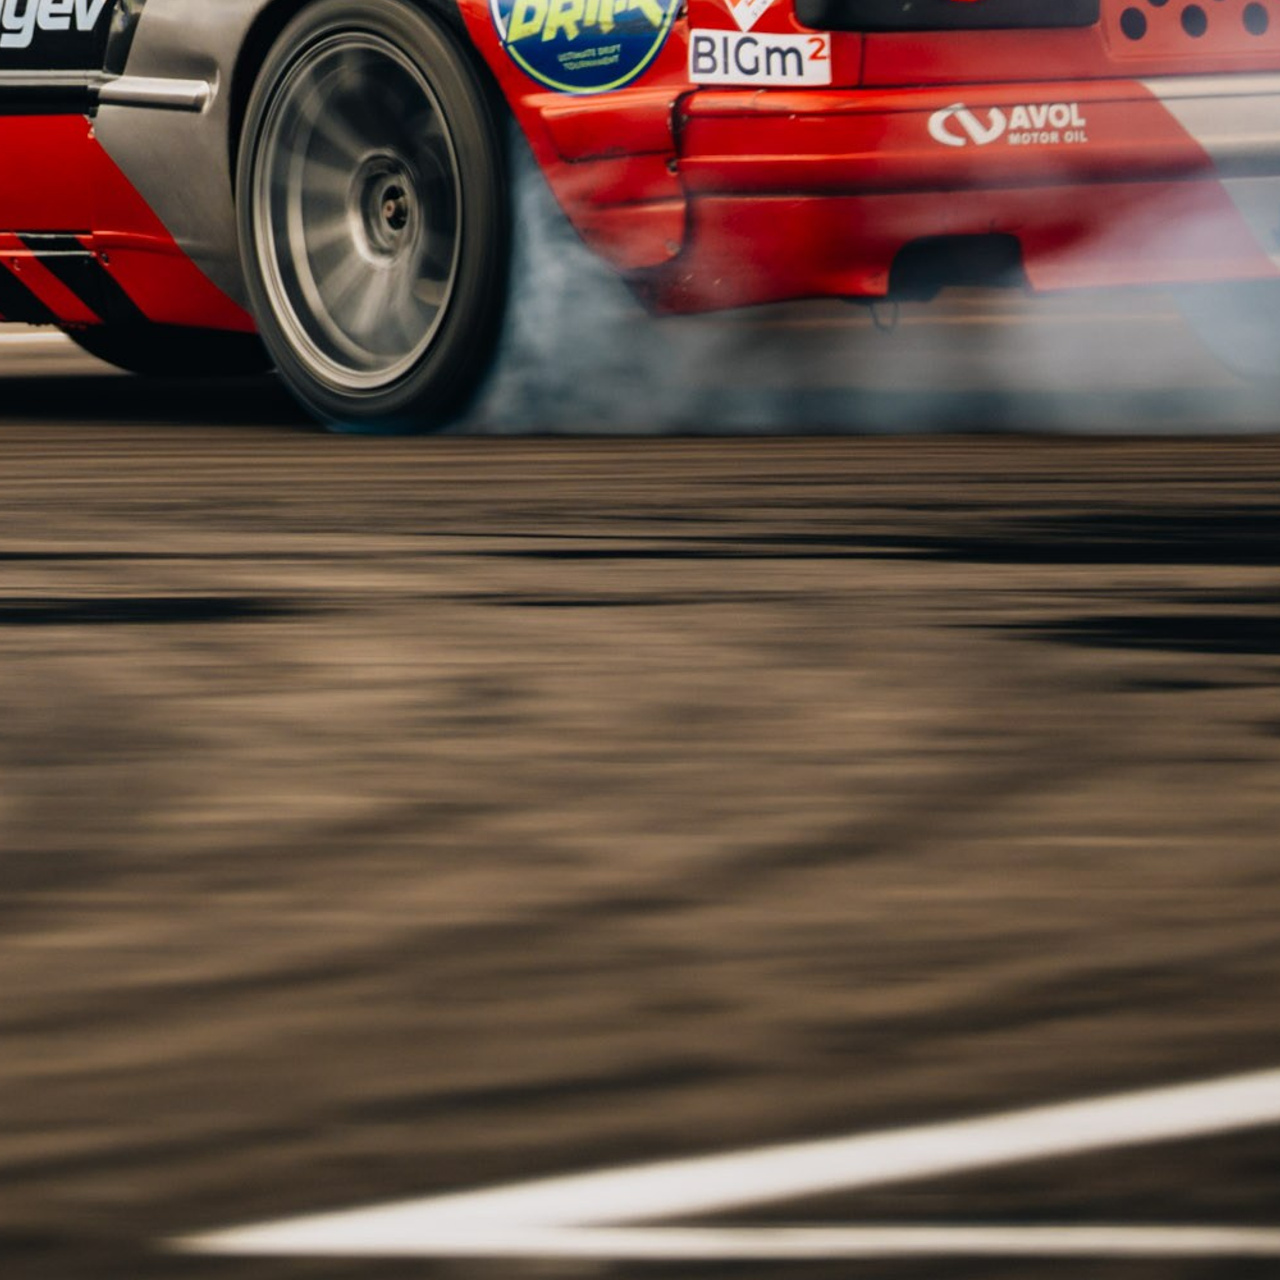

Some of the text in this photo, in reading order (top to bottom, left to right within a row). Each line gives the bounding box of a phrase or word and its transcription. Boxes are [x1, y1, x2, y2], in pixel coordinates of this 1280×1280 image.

[1008, 103, 1086, 129] AVOL
[1008, 130, 1088, 145] MOTOR OIL
